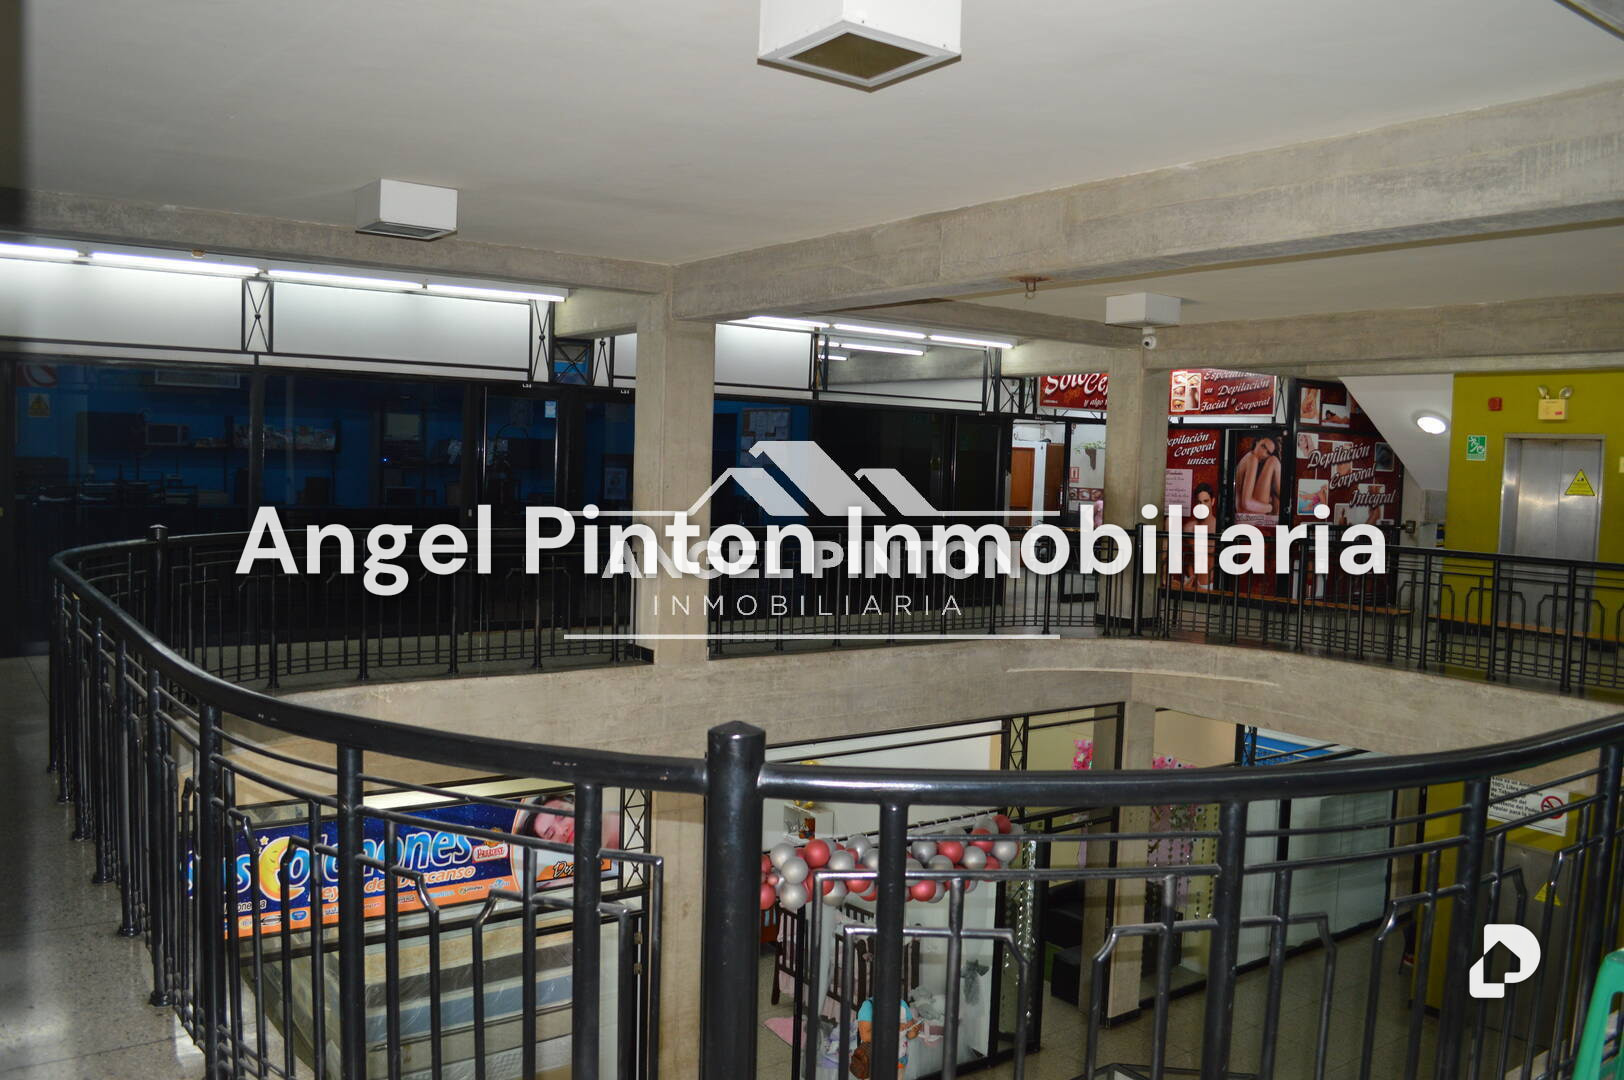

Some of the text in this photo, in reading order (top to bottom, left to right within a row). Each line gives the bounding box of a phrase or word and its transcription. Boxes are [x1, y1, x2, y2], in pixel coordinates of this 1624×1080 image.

[1218, 378, 1271, 396] Depilación
[1235, 397, 1271, 411] Corporal
[1167, 431, 1210, 447] epilación
[1174, 440, 1217, 457] Corporal
[1307, 442, 1371, 468] Depilación
[1187, 456, 1217, 465] unisex
[1329, 463, 1376, 490] Corporal
[1349, 488, 1397, 508] Integral
[364, 876, 392, 893] de
